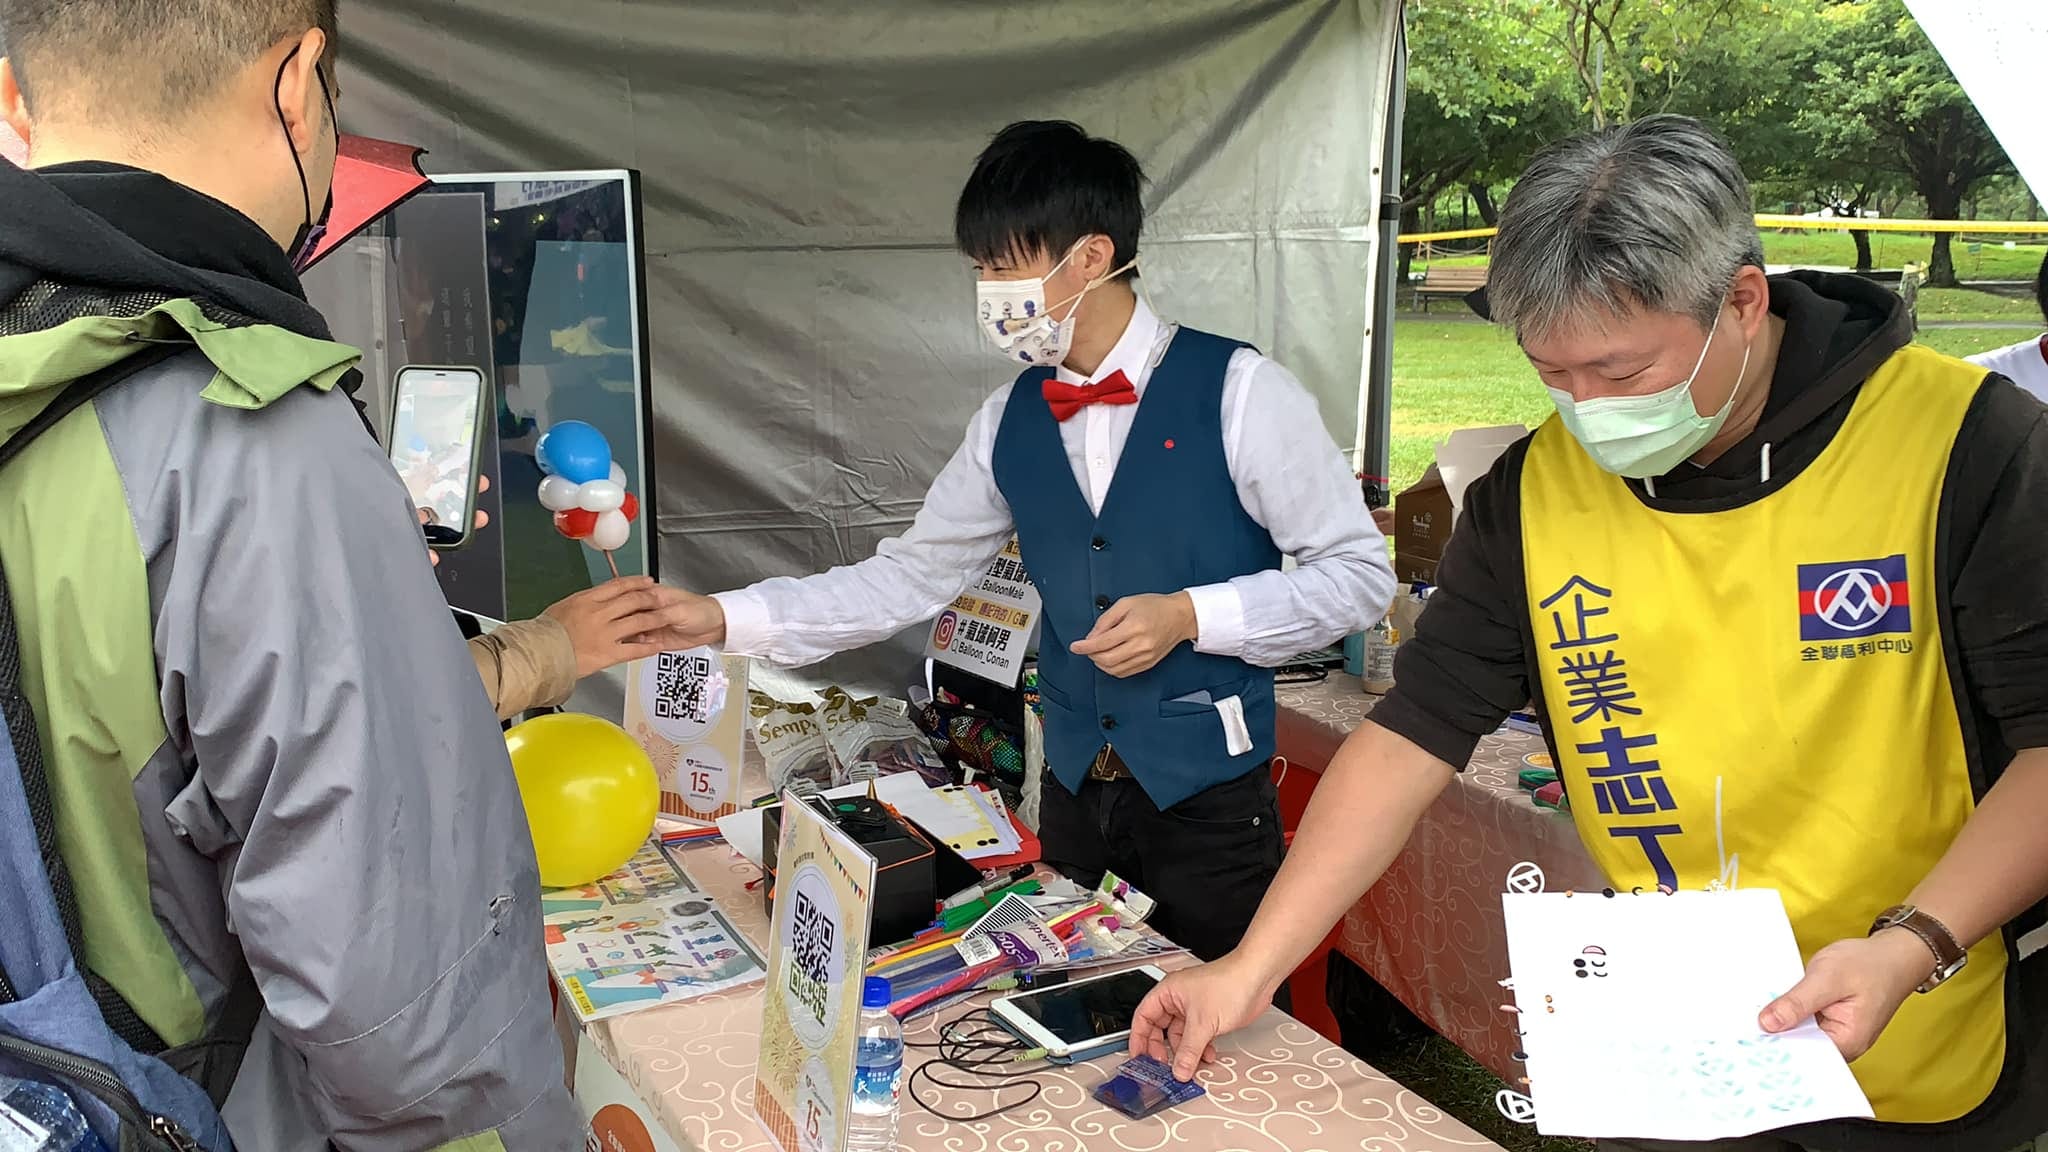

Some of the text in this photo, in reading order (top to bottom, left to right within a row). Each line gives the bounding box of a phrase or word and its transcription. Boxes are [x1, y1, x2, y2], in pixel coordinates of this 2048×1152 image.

[986, 557, 1034, 586] 型氣球
[1800, 638, 1913, 662] 全聯福利中心
